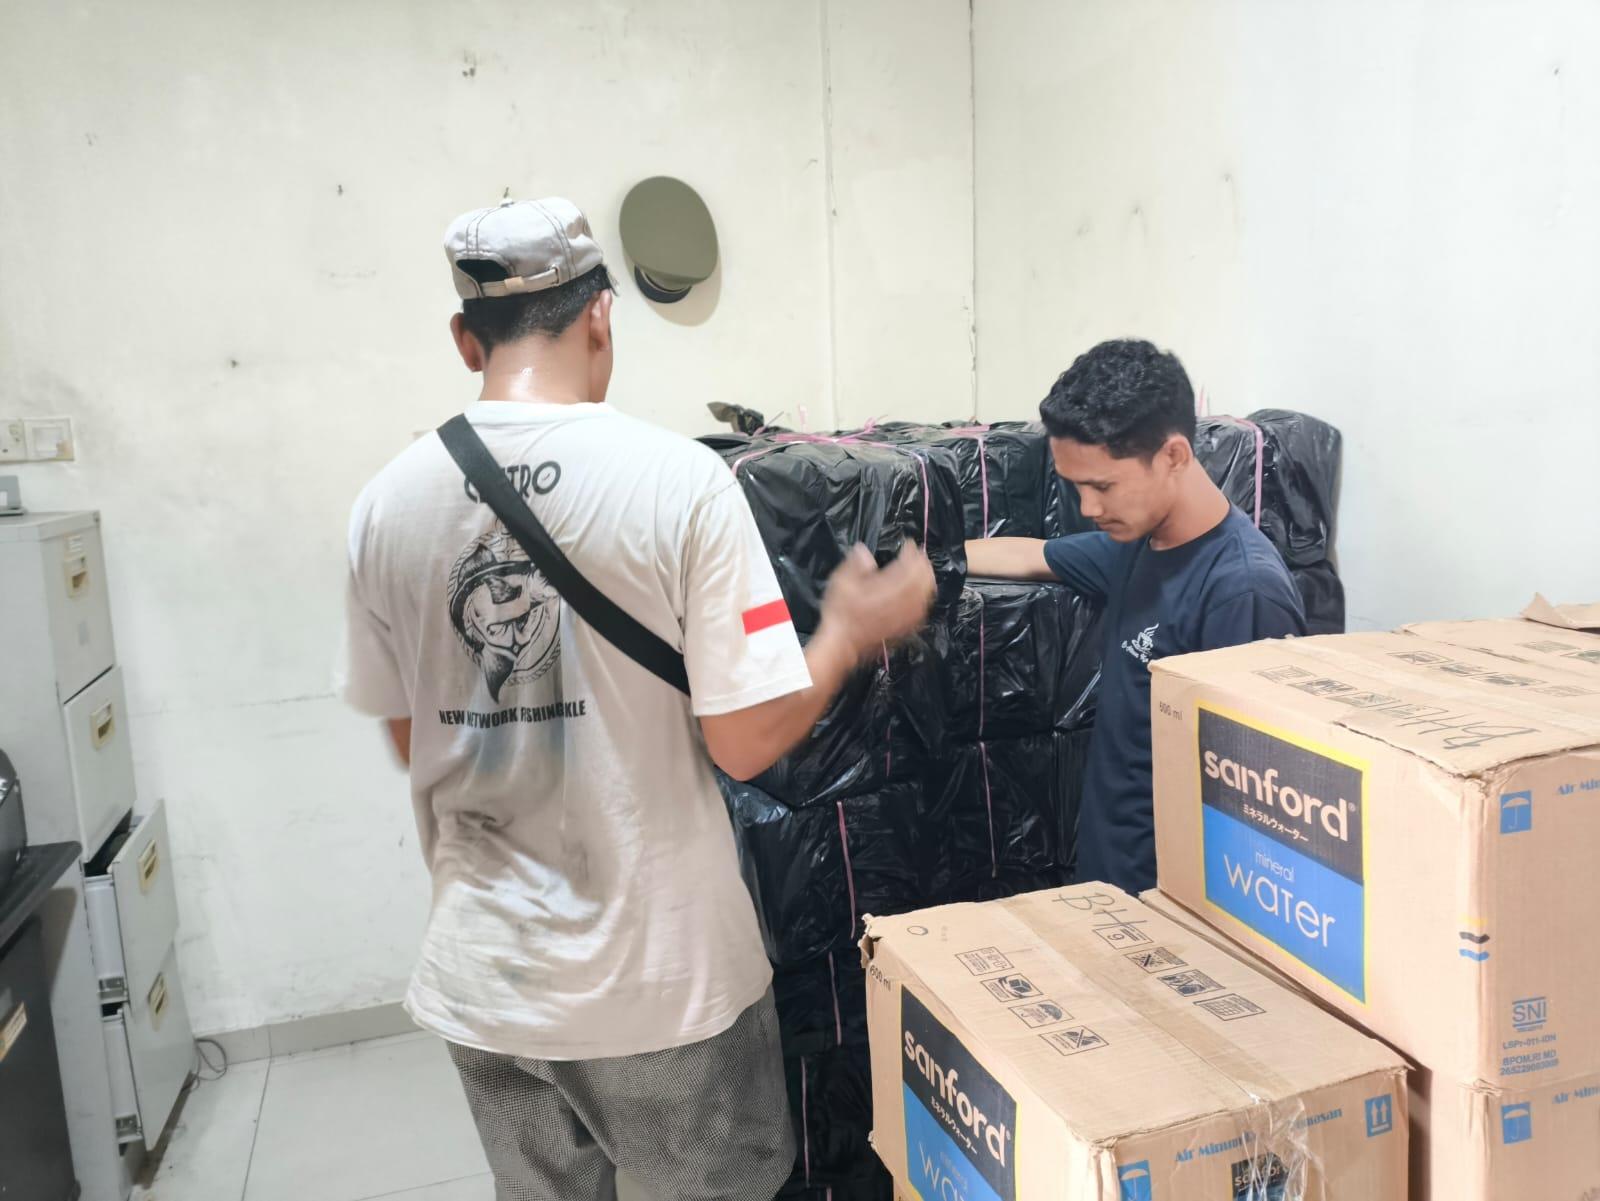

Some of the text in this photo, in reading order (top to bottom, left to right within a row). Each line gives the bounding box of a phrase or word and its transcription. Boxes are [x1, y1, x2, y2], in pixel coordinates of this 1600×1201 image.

[438, 709, 465, 725] NEW
[466, 706, 518, 729] NETWORK
[1203, 750, 1348, 842] sanford
[1242, 803, 1310, 843] ミネラルウォーター
[1255, 850, 1295, 882] mineral
[869, 964, 883, 985] 600
[1512, 1000, 1547, 1023] SNI
[904, 1029, 1005, 1168] sanford
[1174, 1147, 1196, 1163] Air
